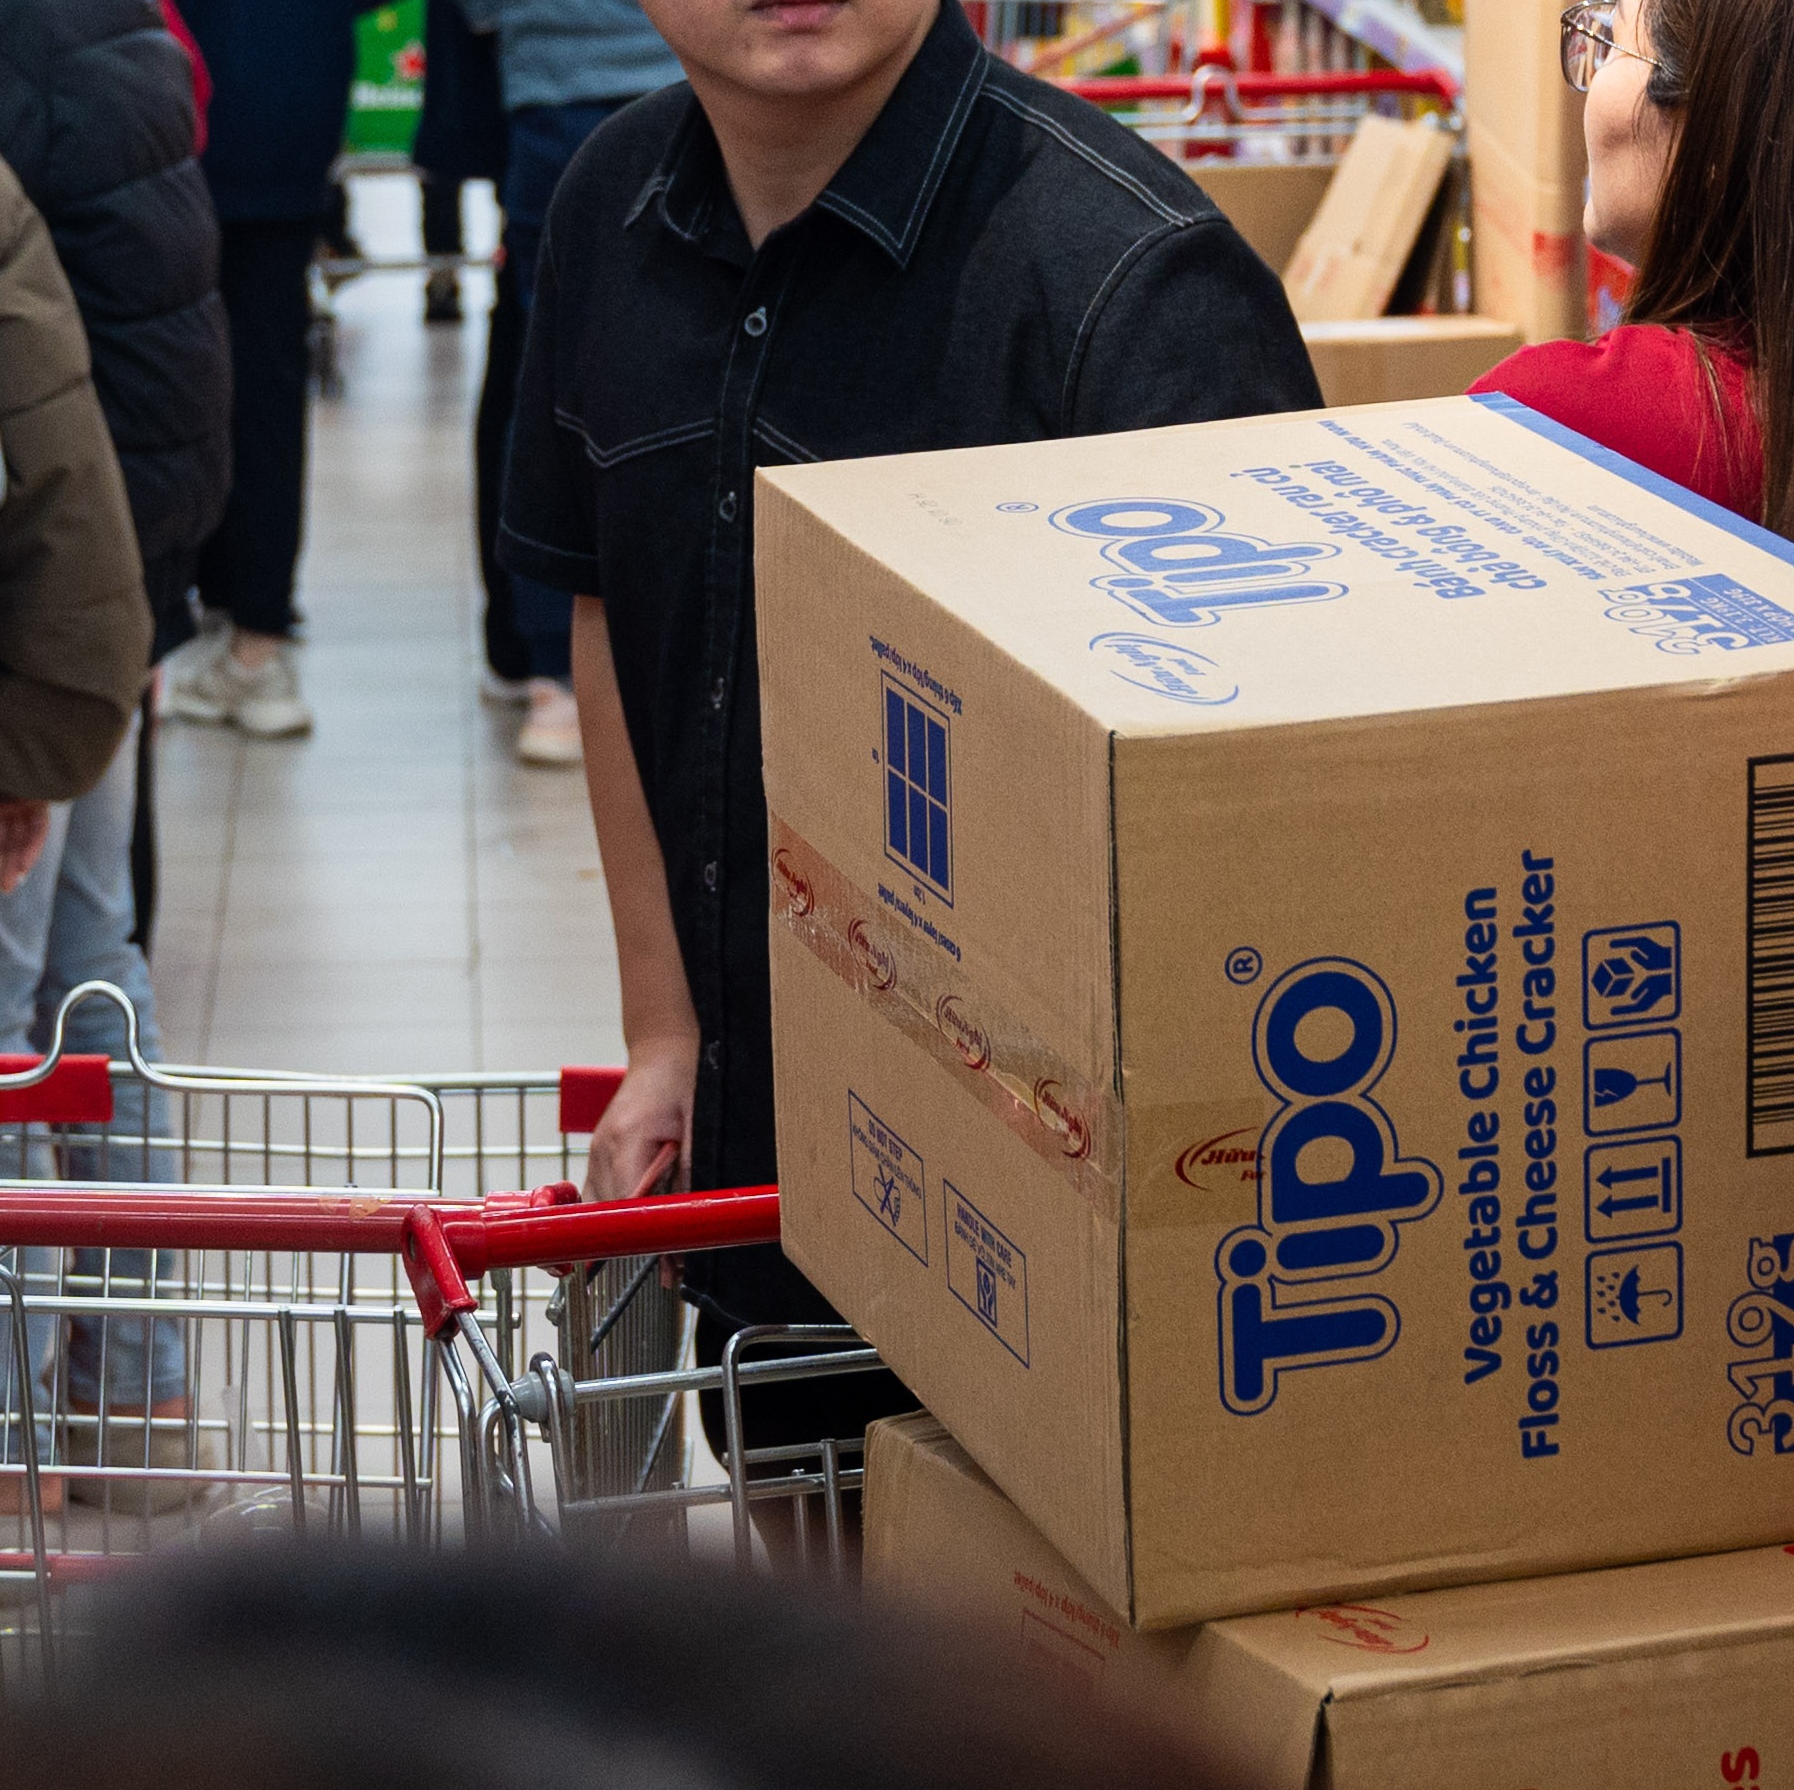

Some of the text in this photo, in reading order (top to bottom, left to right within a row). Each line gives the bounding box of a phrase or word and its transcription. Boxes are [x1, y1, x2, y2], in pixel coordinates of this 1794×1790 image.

[1284, 459, 1372, 488] mai
[1326, 485, 1431, 516] phô
[1381, 513, 1441, 527] &
[1048, 495, 1348, 627] Tipo
[1222, 466, 1492, 600] Bánh cracker rau củ
[1395, 524, 1515, 564] bông
[1562, 581, 1789, 656] 319g
[1215, 956, 1444, 1416] Tipo
[1456, 886, 1512, 1385] Vegetable Chicken
[1515, 850, 1560, 1459] Floss & Cheese Cracker
